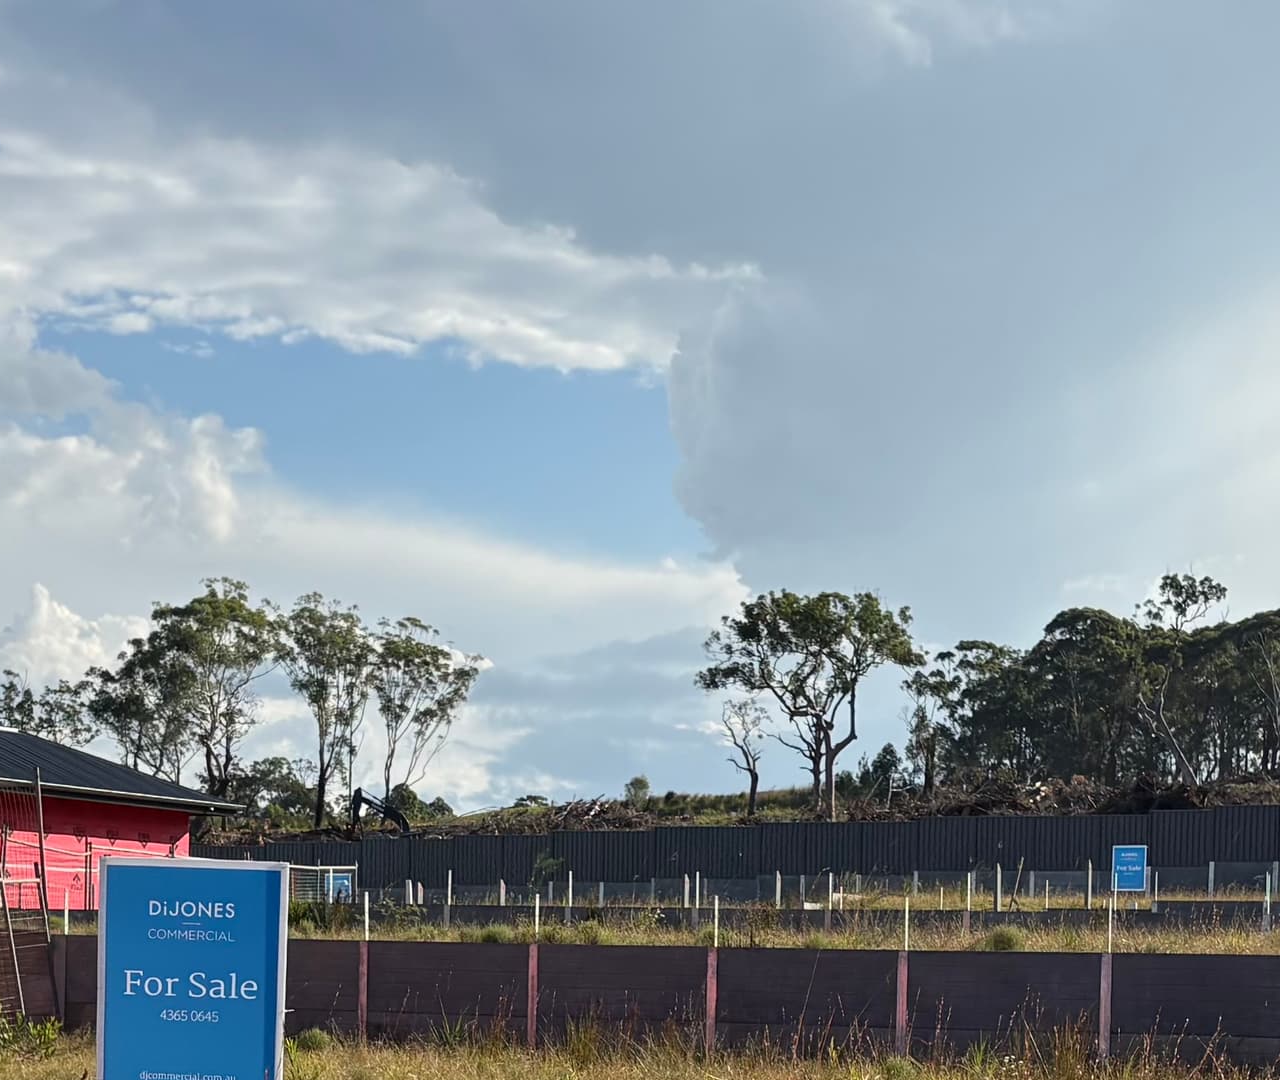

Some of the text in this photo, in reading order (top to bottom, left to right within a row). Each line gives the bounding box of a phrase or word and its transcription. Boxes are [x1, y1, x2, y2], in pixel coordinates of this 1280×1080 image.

[147, 928, 235, 942] COMMERCIAL
[123, 969, 259, 1000] For Sale
[159, 1009, 220, 1023] 4365 0645
